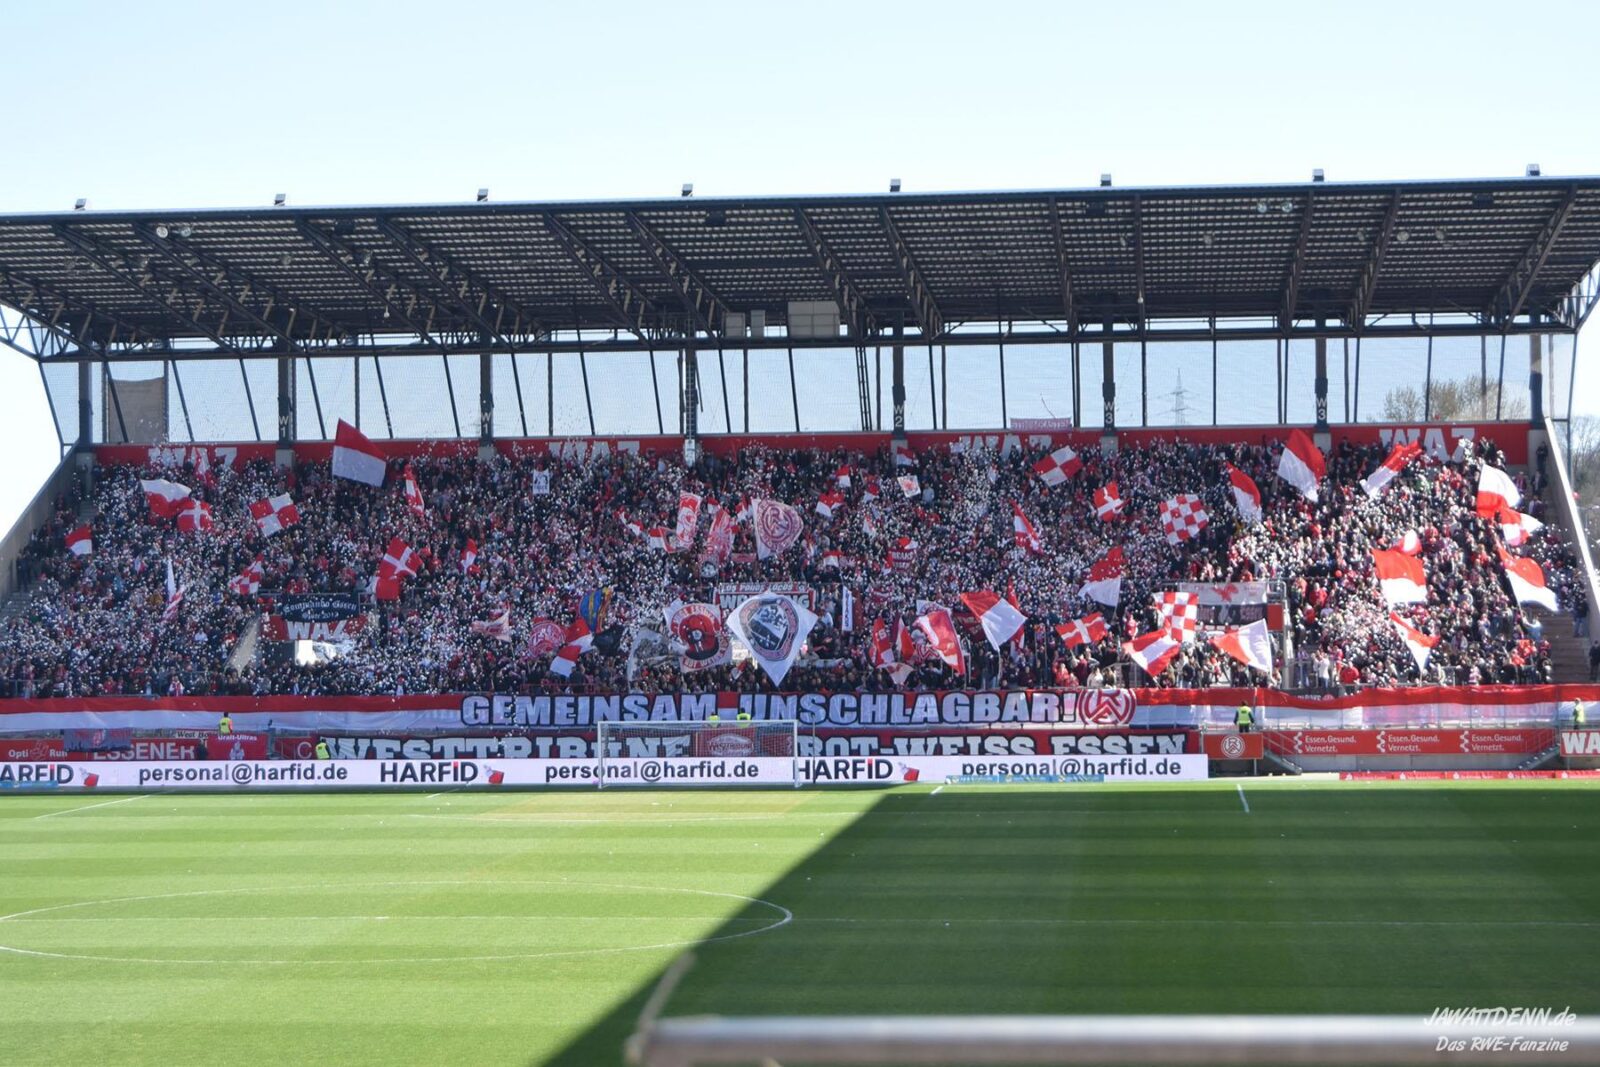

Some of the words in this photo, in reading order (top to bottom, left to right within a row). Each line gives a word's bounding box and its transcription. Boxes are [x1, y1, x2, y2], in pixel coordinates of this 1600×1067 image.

[1104, 402, 1114, 411] W
[1317, 398, 1327, 407] W
[894, 405, 904, 414] W
[1318, 409, 1326, 420] 3
[279, 416, 289, 426] W
[481, 412, 491, 422] W
[895, 416, 903, 427] 2
[1105, 413, 1113, 424] 3
[281, 427, 286, 438] 1
[483, 424, 488, 434] 1
[1379, 429, 1475, 463] WAZ
[461, 693, 718, 726] GEMEINSAM
[741, 691, 1077, 725] UNSCHLAGBAR!
[797, 736, 1035, 757] ROT-WEISS
[1051, 735, 1186, 755] ESSEN
[8, 749, 29, 759] Opti
[545, 760, 759, 782] personal@harfid.de
[962, 757, 1181, 779] personal@harfid.de
[139, 763, 348, 785] personal@harfid.de
